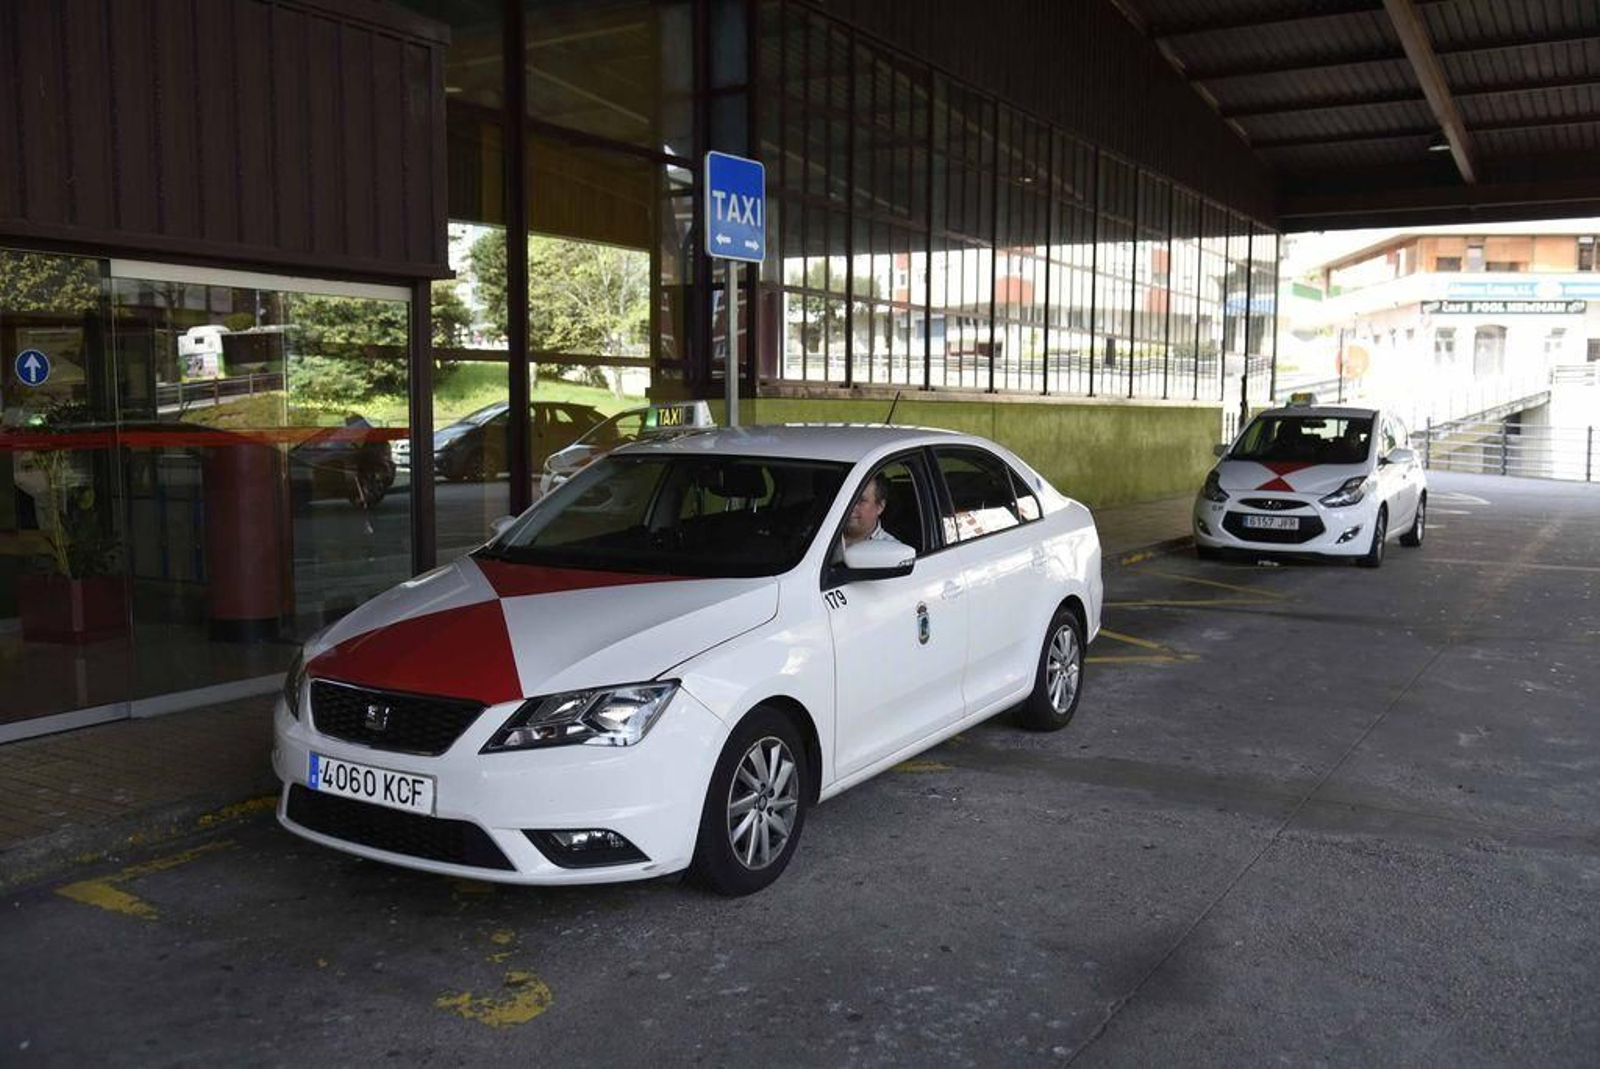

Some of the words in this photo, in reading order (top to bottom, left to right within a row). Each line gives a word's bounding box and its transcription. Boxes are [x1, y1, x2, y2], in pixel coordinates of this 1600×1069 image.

[711, 189, 762, 228] TAXI
[658, 406, 683, 427] TAXI
[824, 589, 848, 610] 179
[321, 760, 377, 798] 4060
[383, 774, 425, 807] KCF
